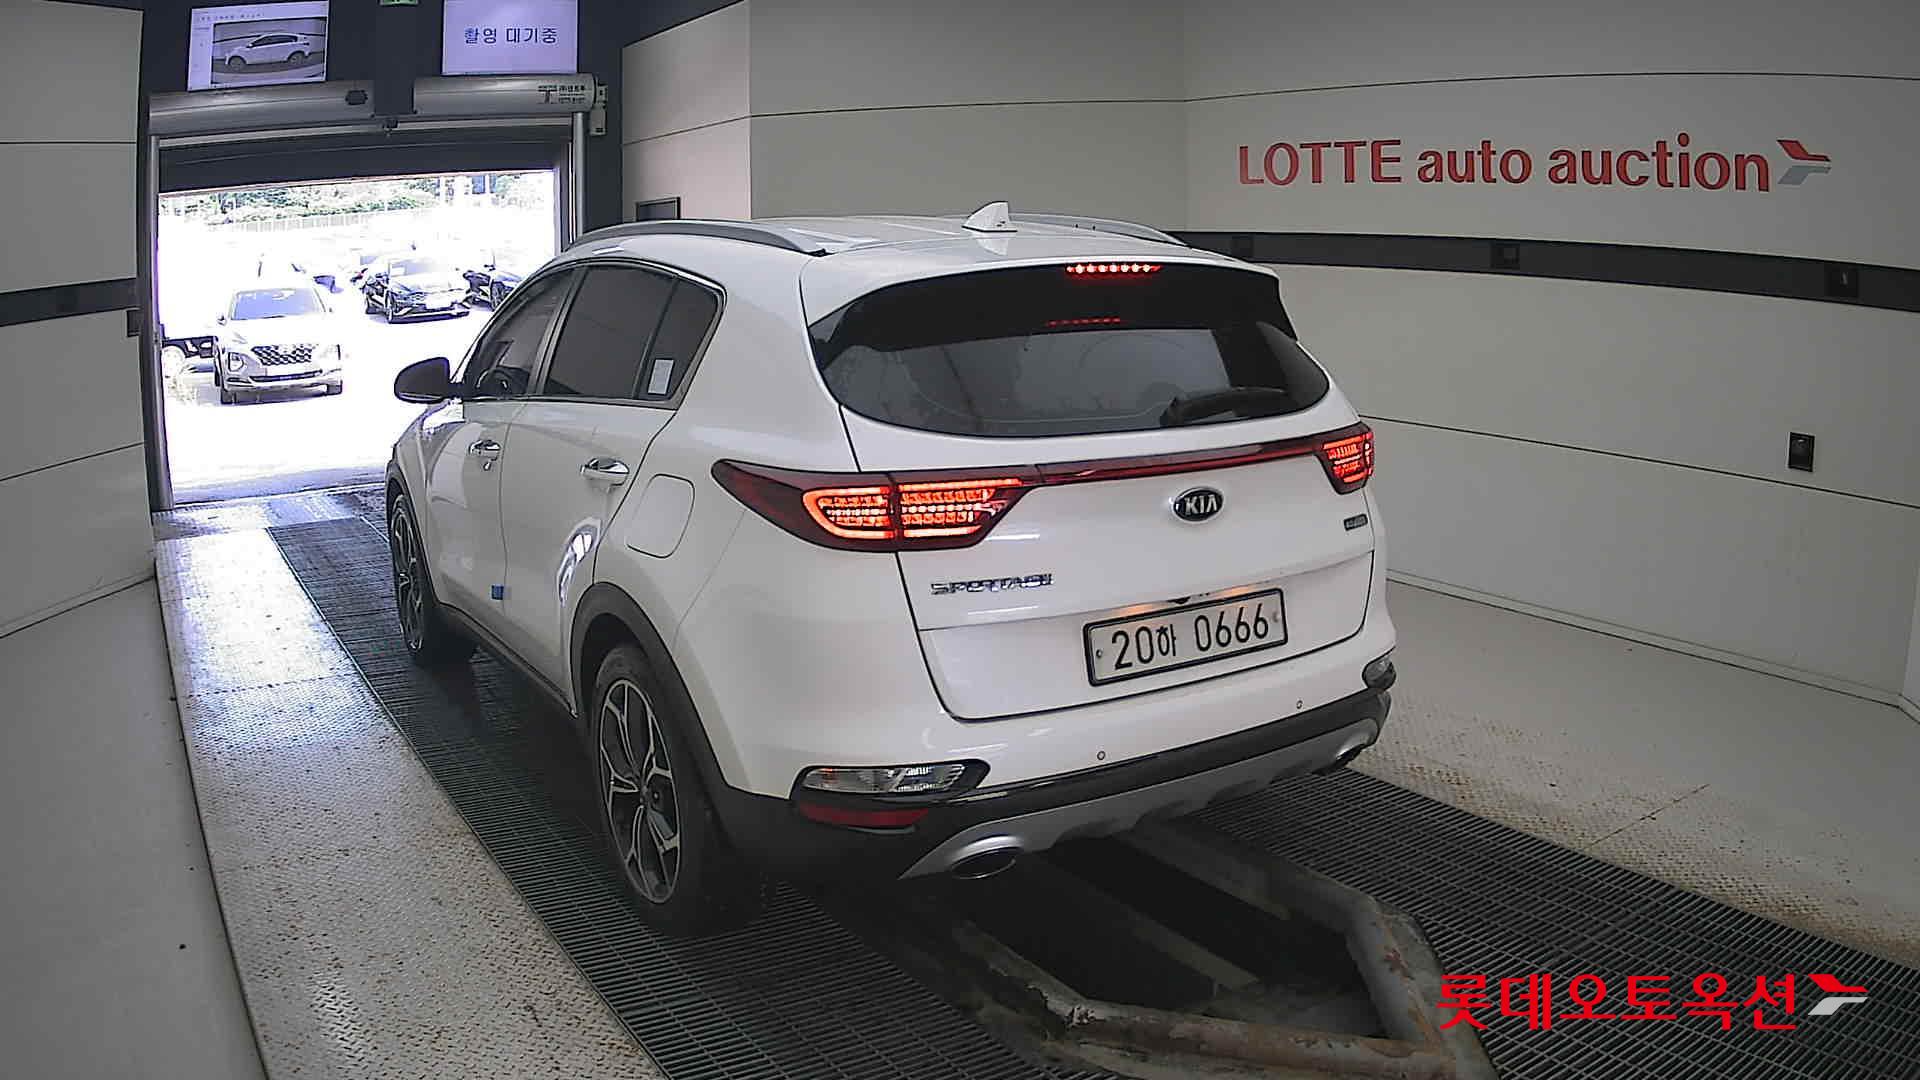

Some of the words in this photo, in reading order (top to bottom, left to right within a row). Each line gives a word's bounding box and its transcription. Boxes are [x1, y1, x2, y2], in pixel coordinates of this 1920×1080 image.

[464, 27, 497, 45] 촬영
[505, 27, 558, 45] 대기중
[1239, 140, 1402, 186] LOTTE
[1416, 140, 1533, 184] auto
[1548, 133, 1770, 193] auction
[1184, 494, 1218, 516] KIA
[1111, 613, 1177, 670] 20하
[1194, 603, 1269, 652] 0666
